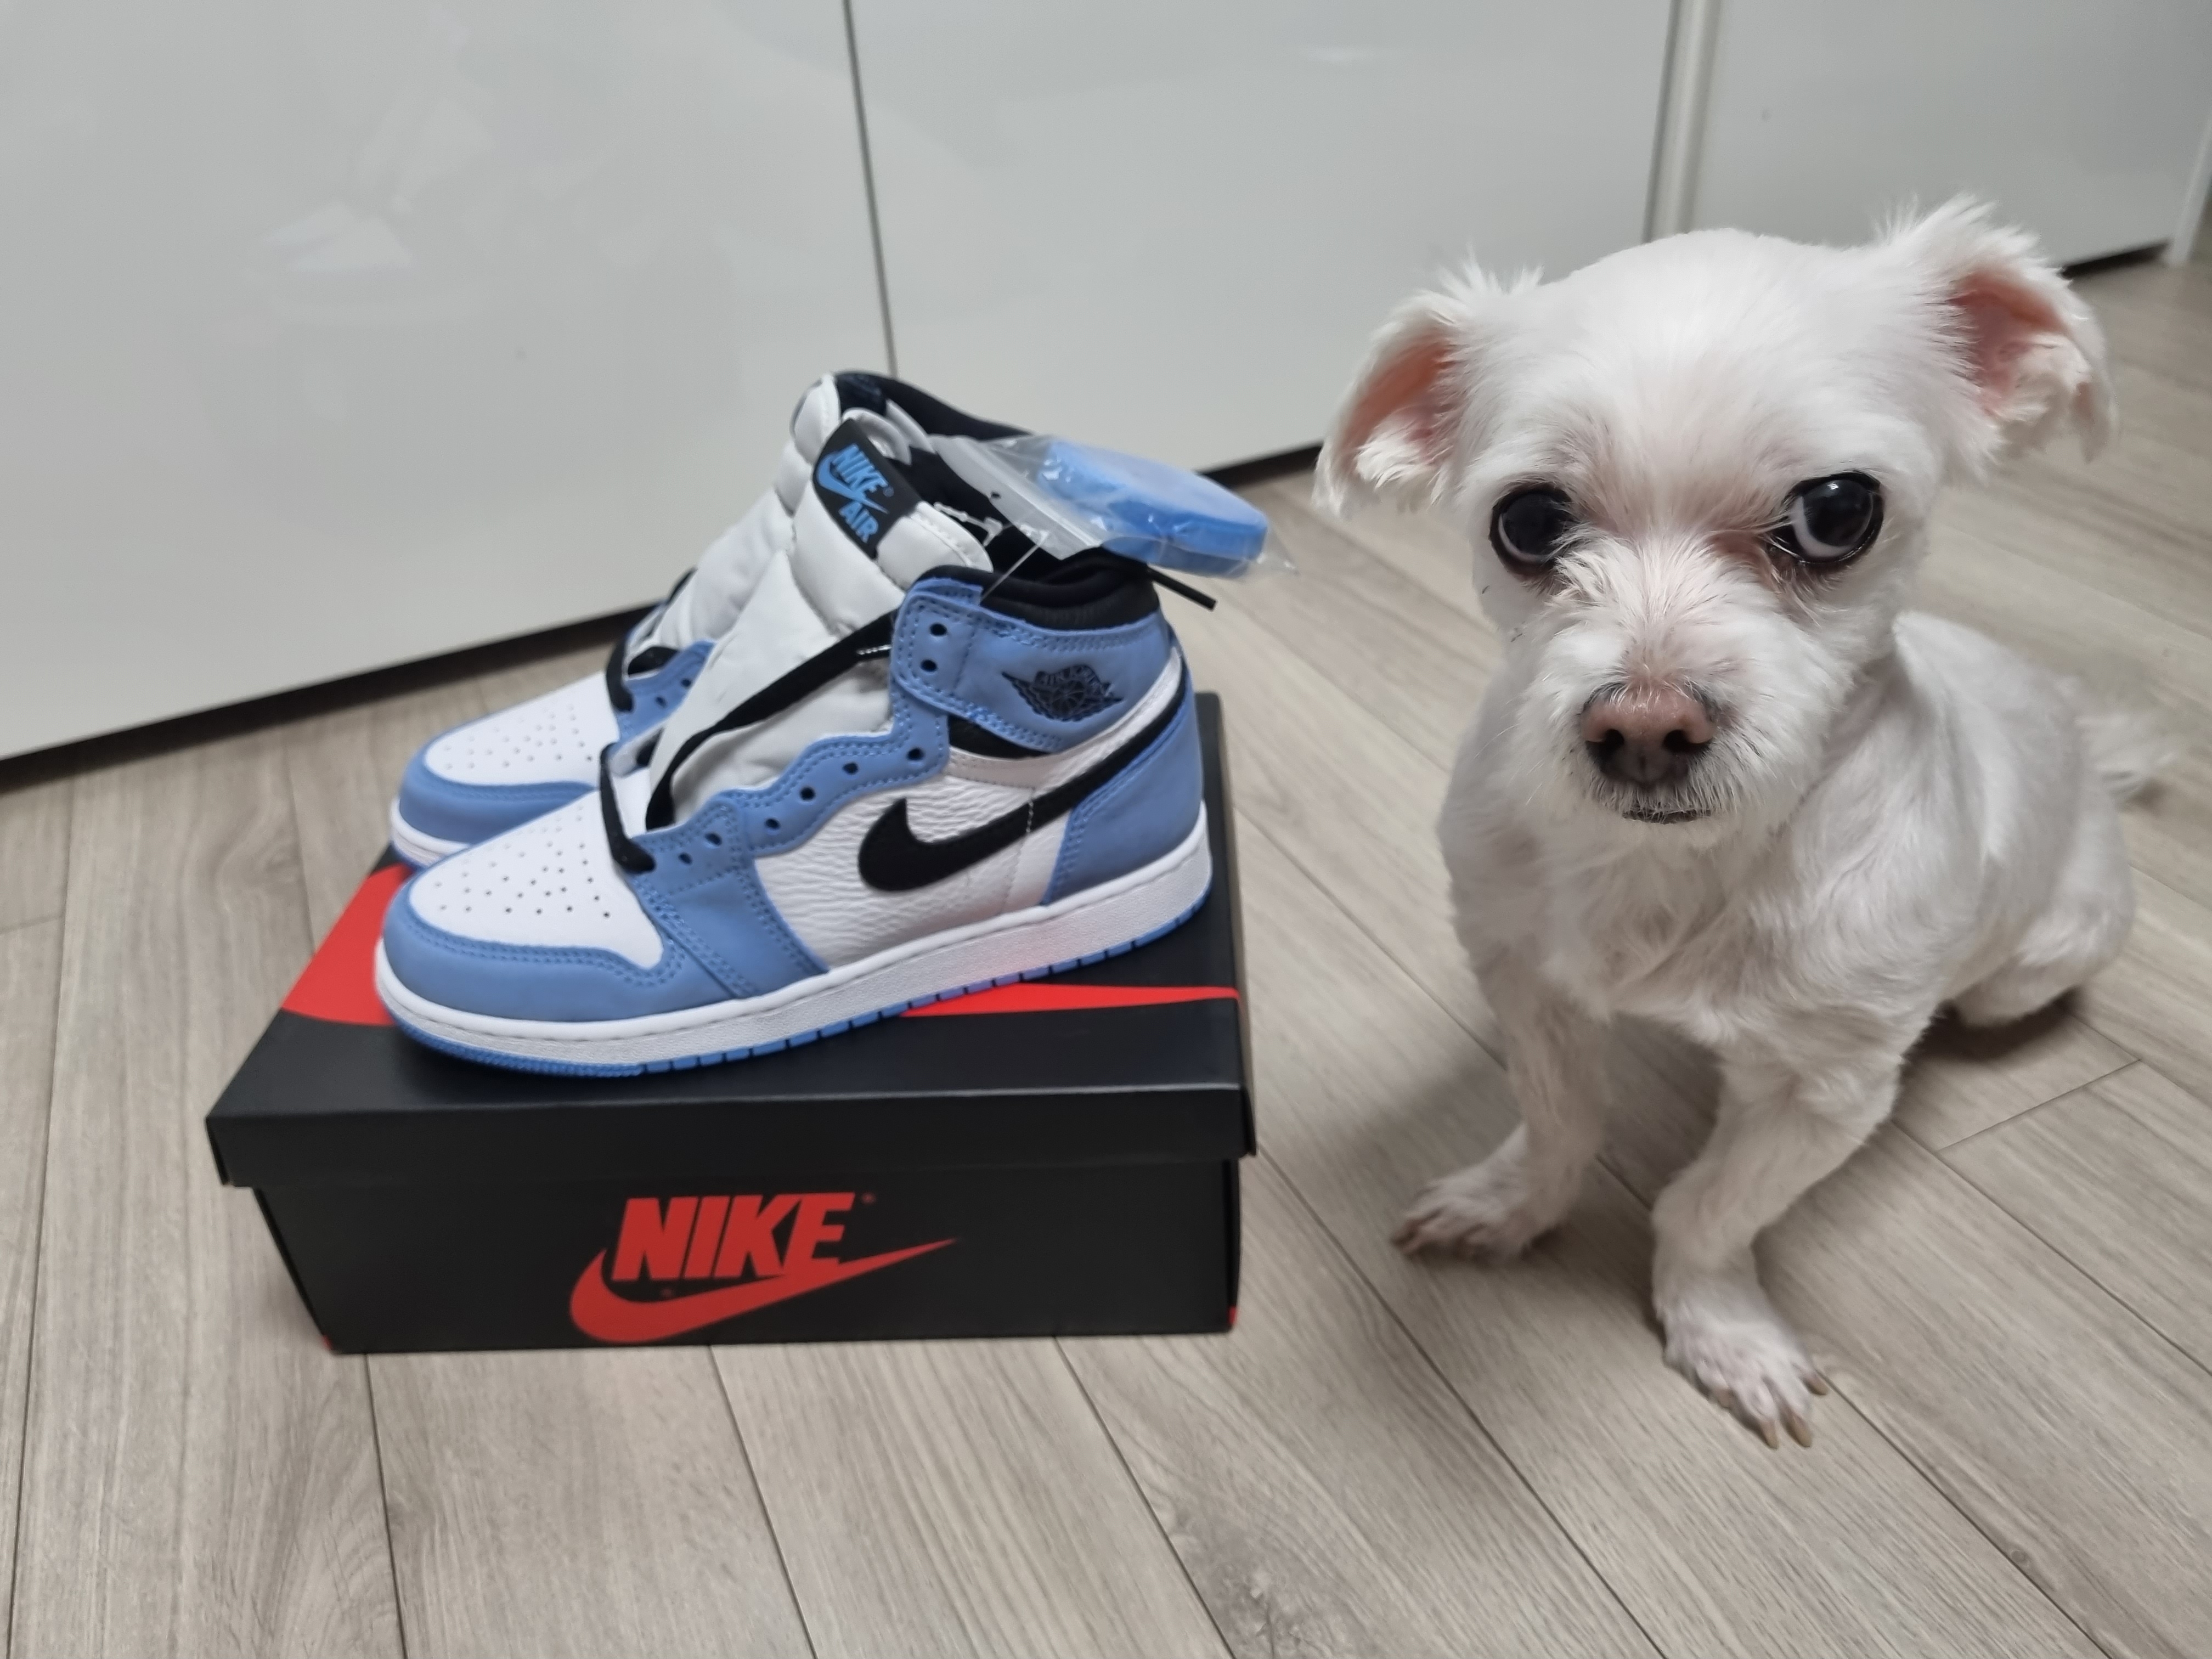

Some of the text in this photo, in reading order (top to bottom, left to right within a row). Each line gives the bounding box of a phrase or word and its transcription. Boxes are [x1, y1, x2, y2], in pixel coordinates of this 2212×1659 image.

[832, 443, 888, 492] NIKE
[839, 502, 878, 543] AIR
[612, 1192, 855, 1281] NIKE
